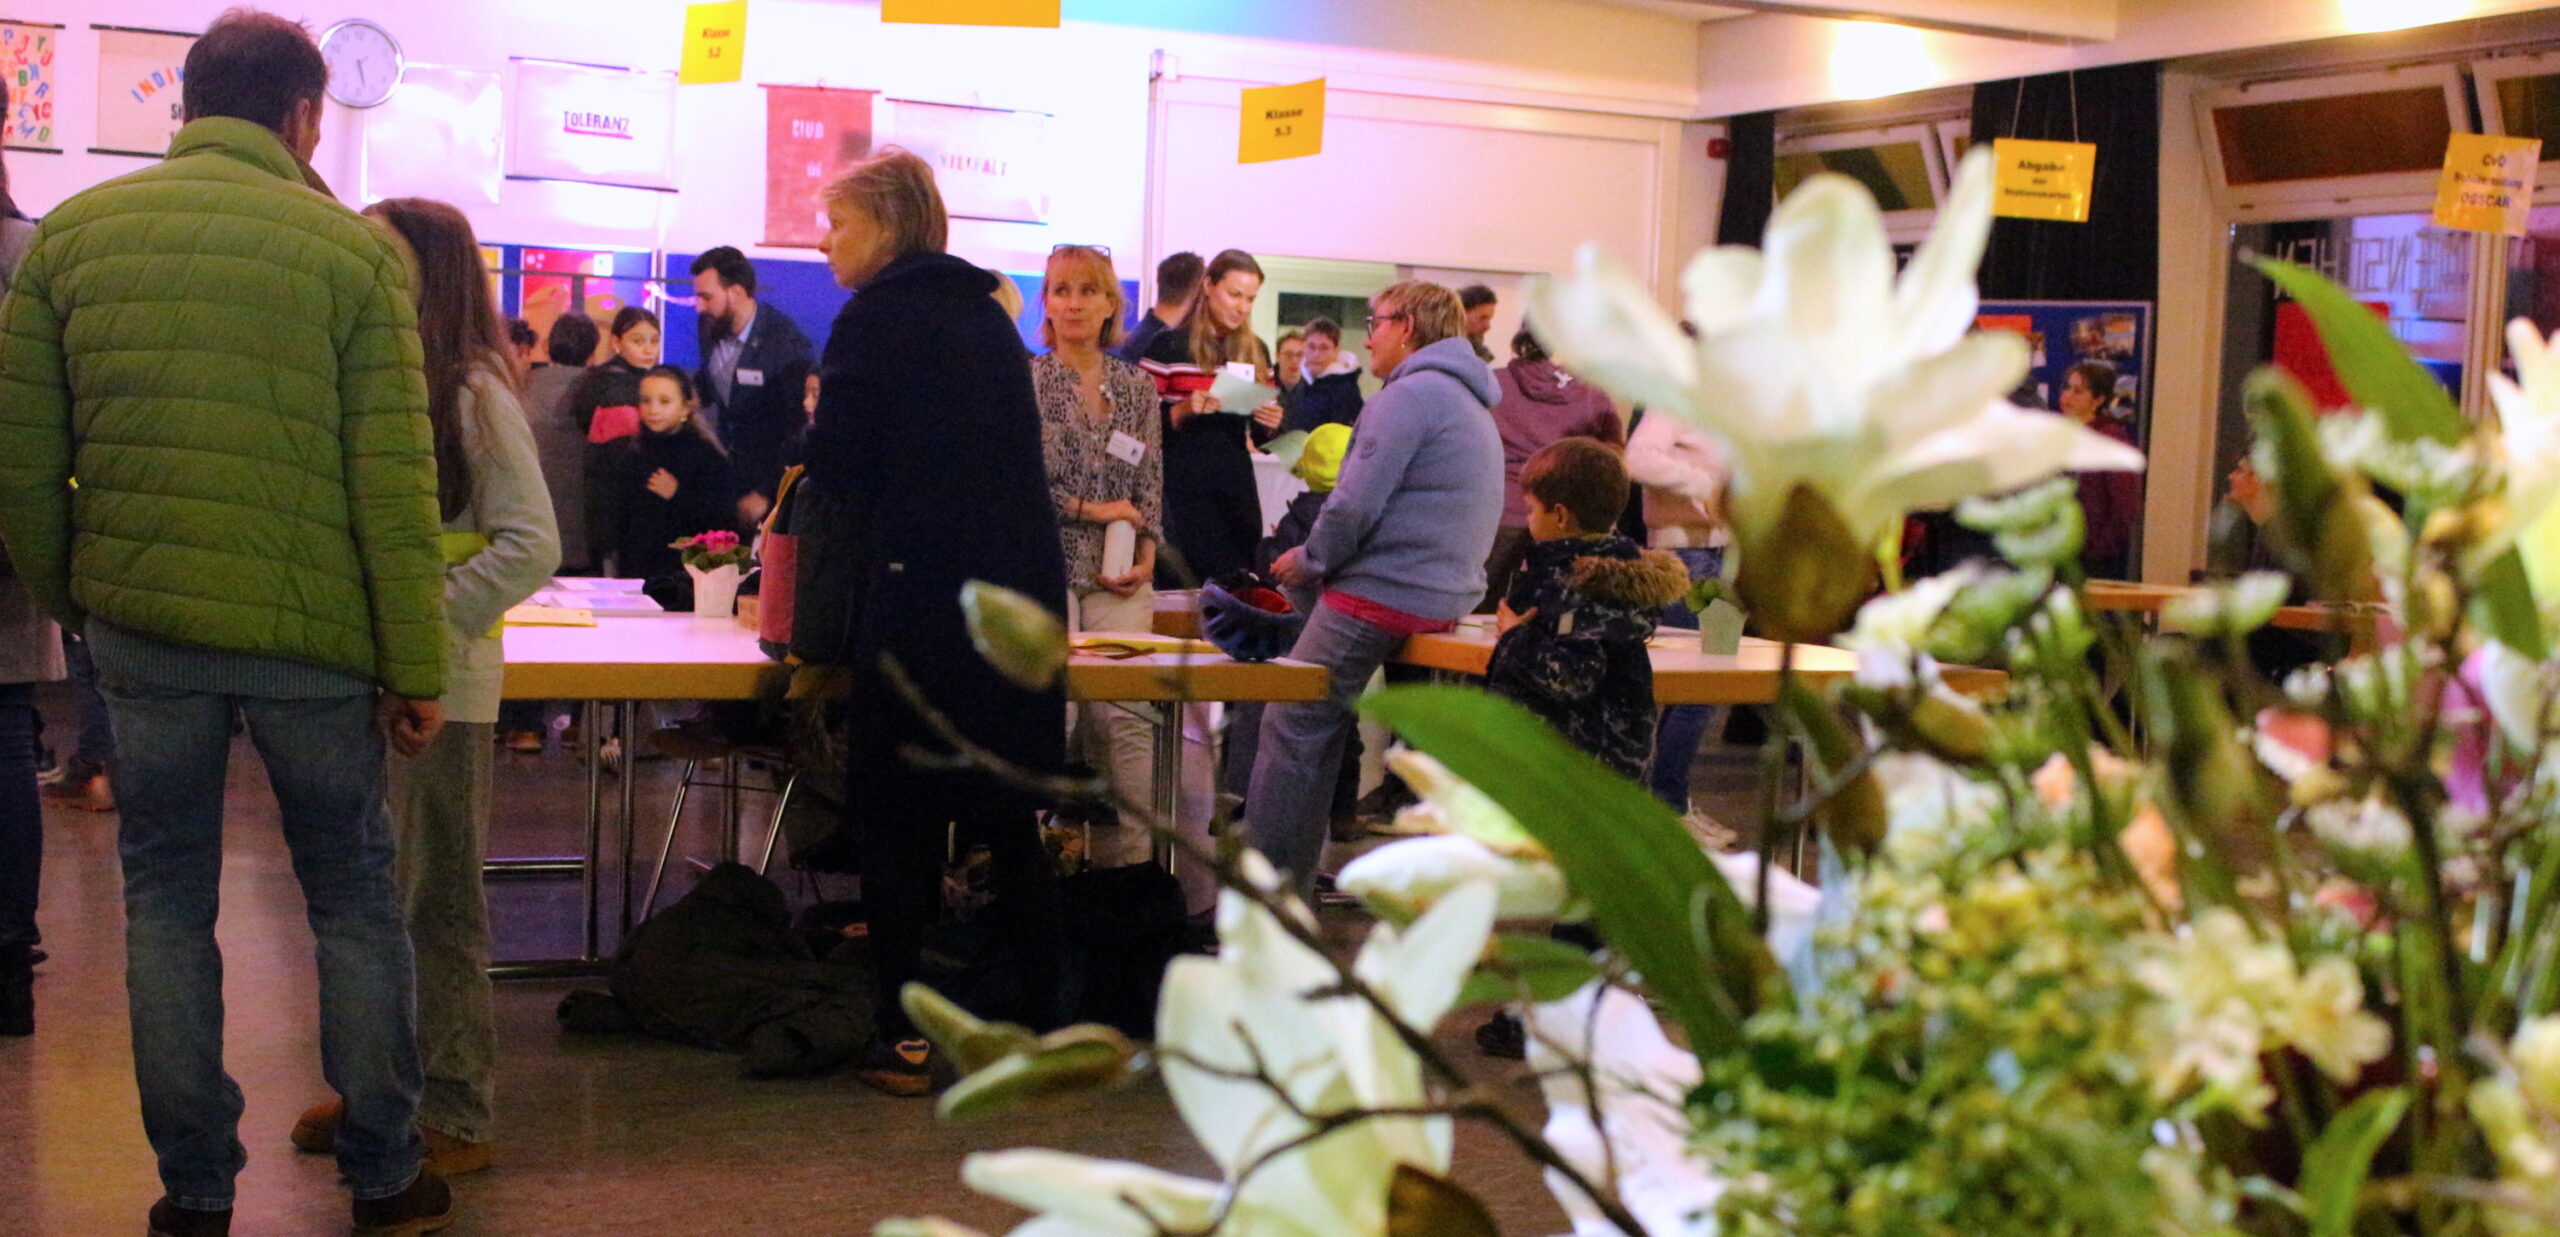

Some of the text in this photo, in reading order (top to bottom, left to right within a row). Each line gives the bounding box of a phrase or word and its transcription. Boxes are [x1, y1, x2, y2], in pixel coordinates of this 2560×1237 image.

[563, 110, 630, 131] TOLERANZ
[1265, 108, 1304, 120] Klasse
[2017, 160, 2066, 173] Abgabe
